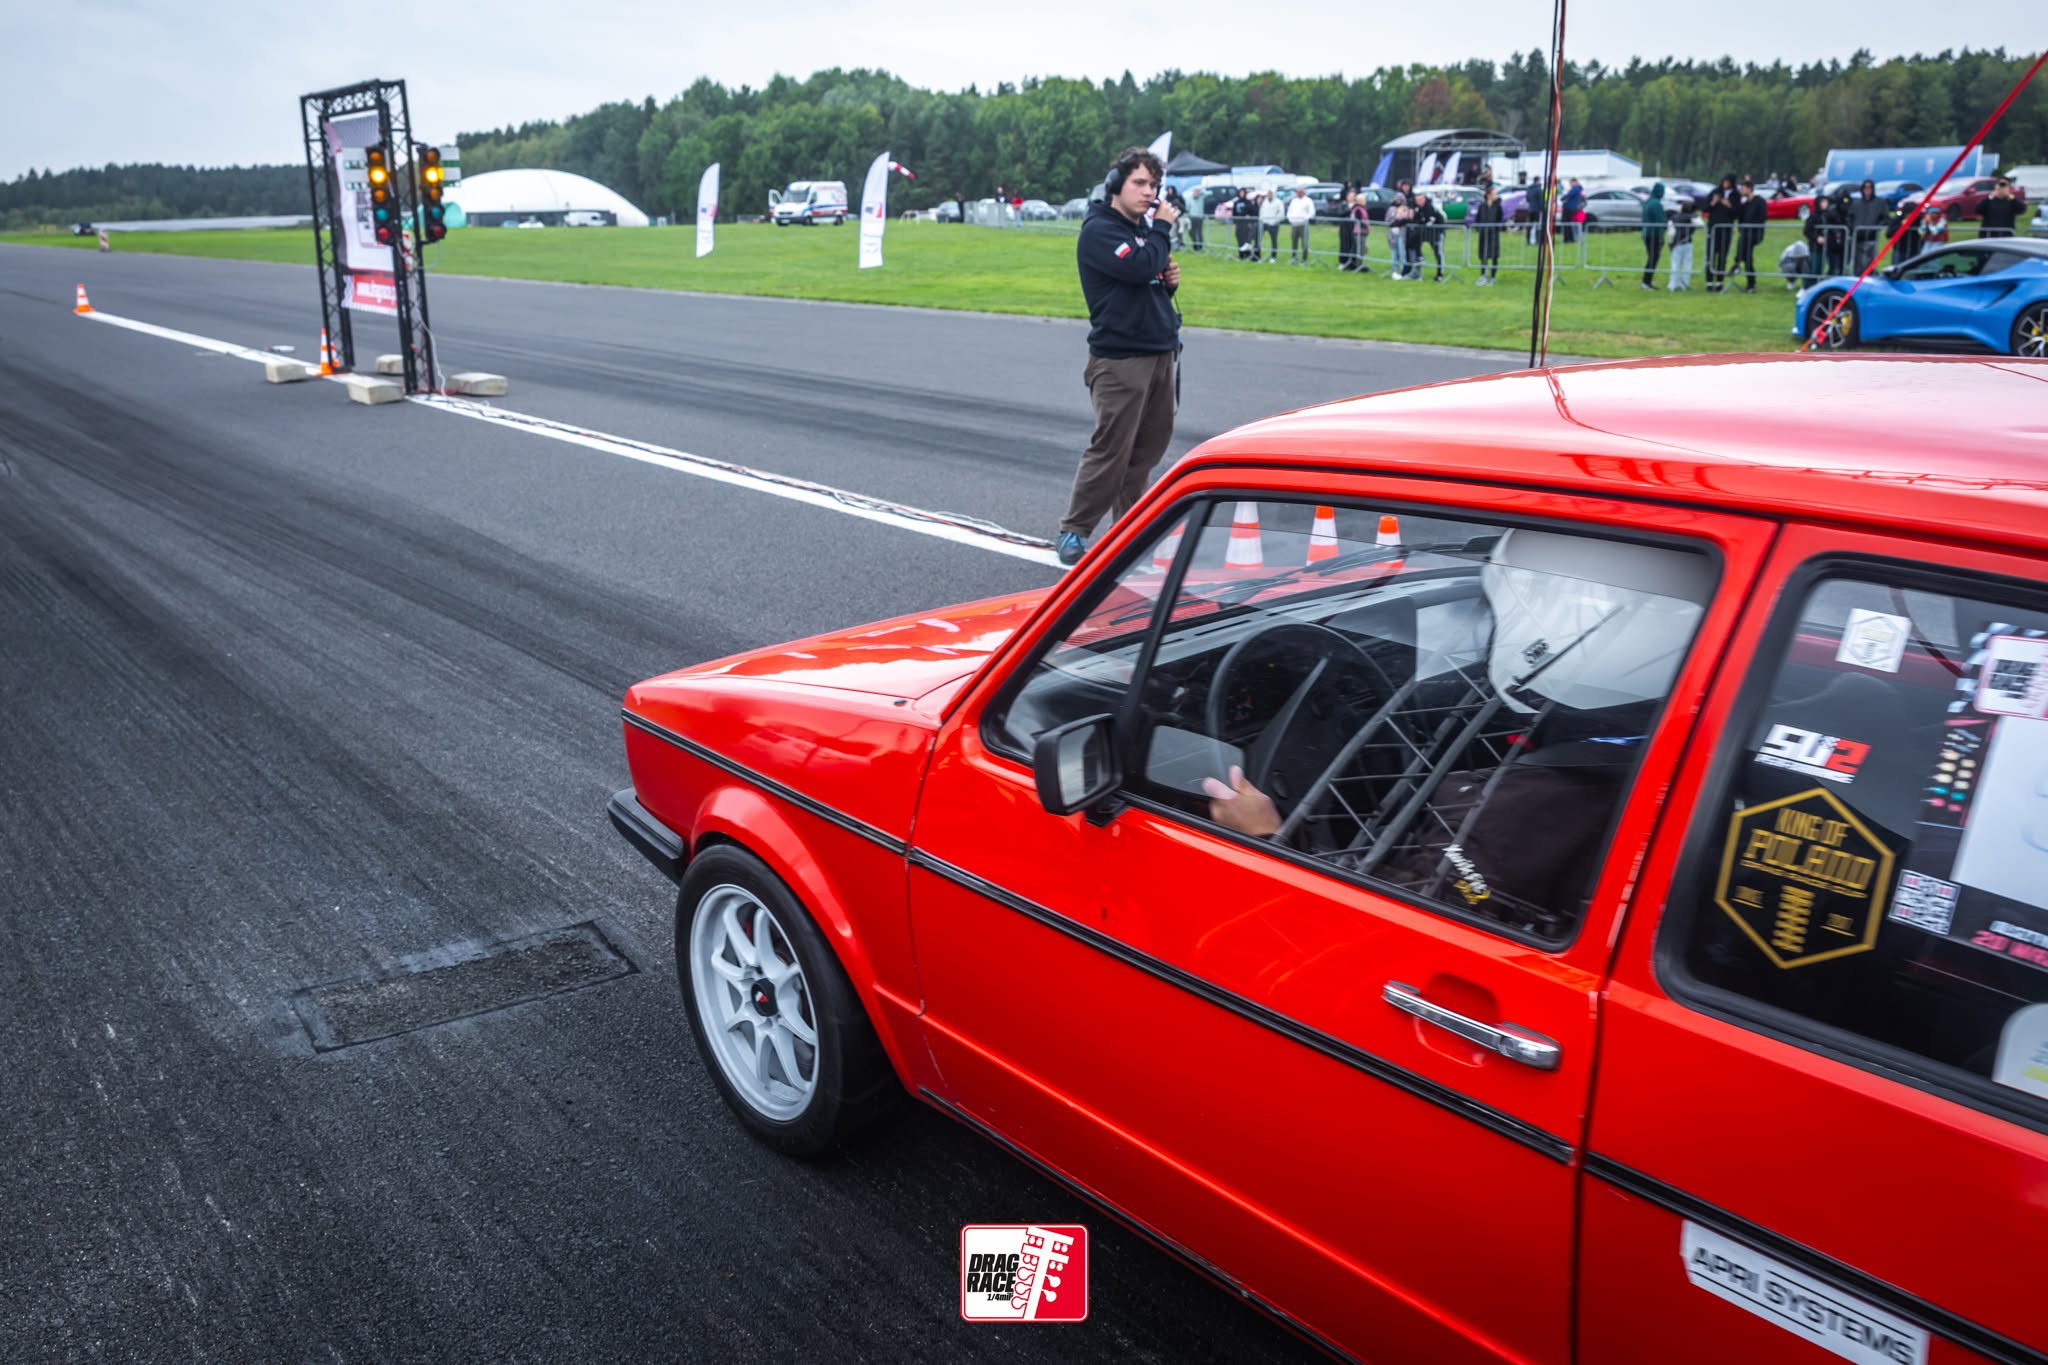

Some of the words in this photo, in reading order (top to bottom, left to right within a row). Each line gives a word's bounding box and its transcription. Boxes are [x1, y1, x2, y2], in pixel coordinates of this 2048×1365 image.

[1742, 828, 1876, 890] POLAND
[1820, 819, 1850, 847] OF
[1691, 1247, 1760, 1294] APRI
[1764, 1279, 1915, 1365] SYSTEMS
